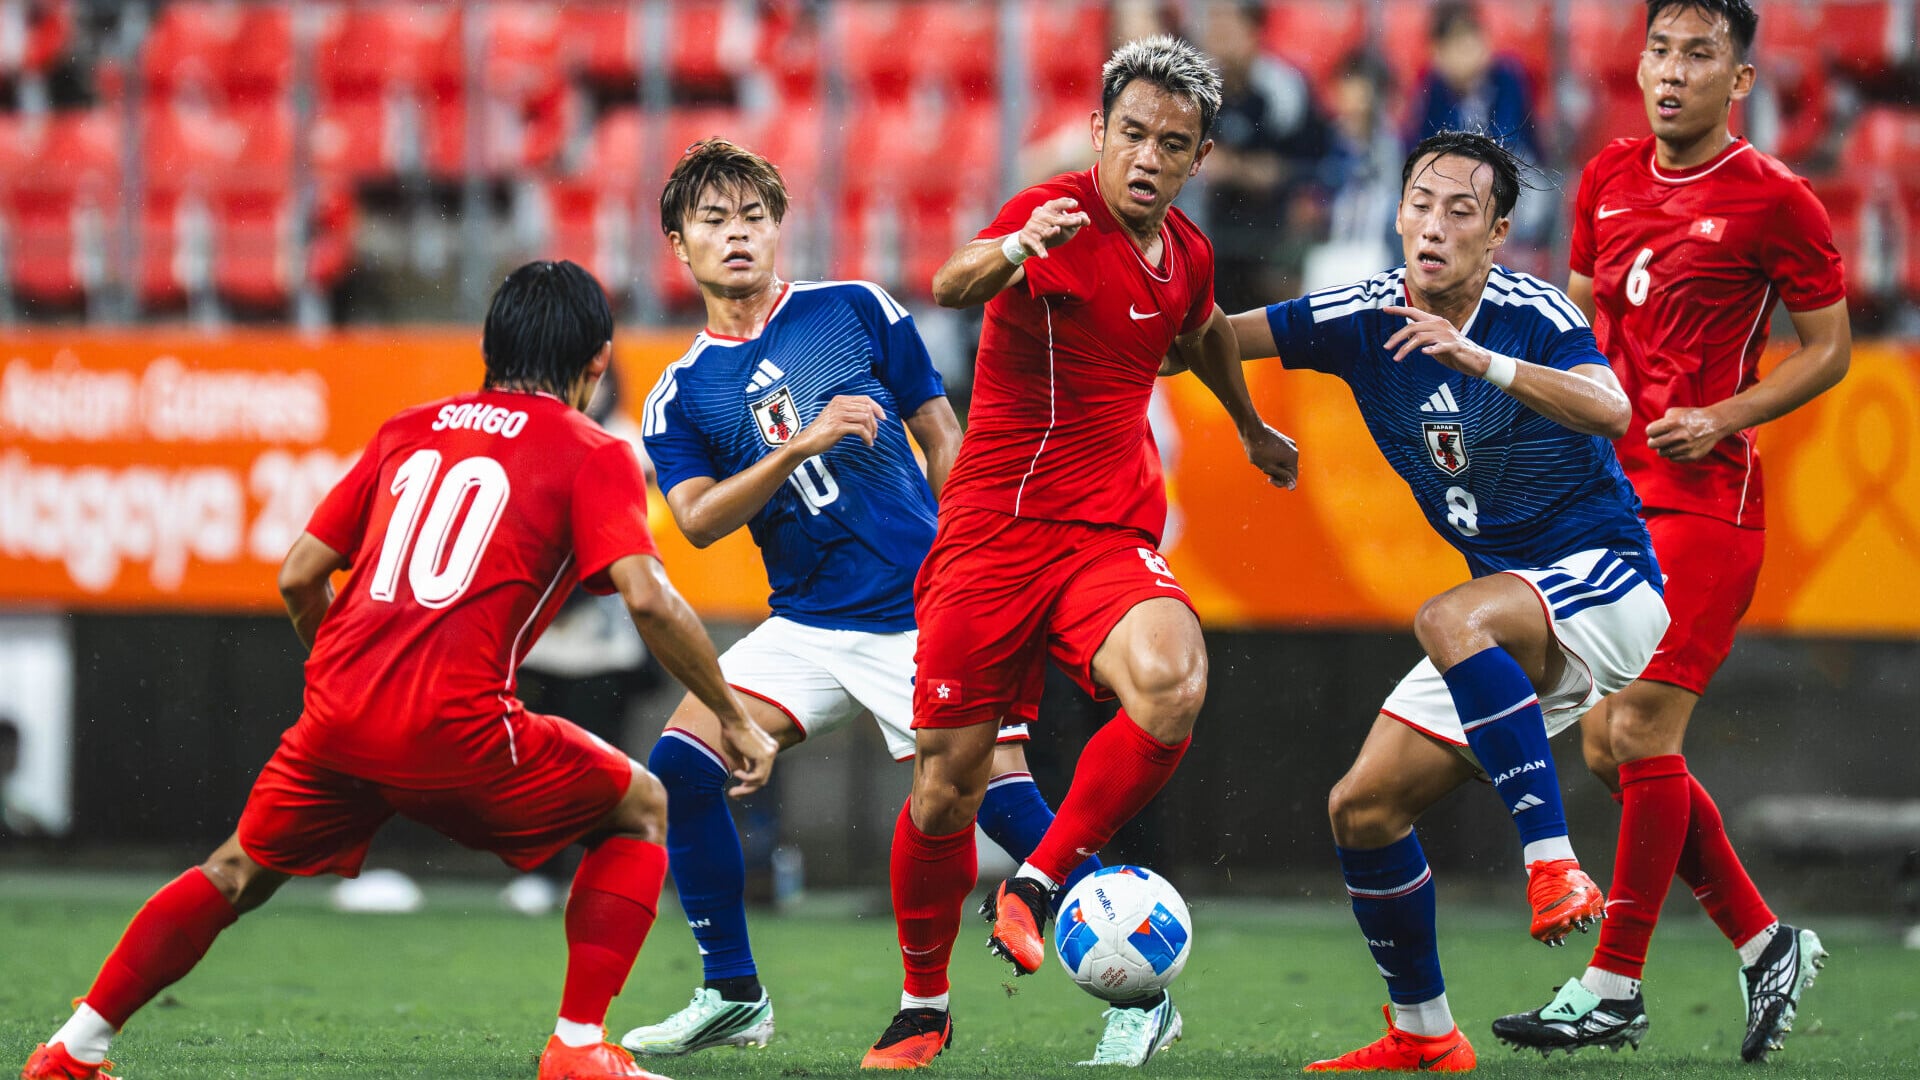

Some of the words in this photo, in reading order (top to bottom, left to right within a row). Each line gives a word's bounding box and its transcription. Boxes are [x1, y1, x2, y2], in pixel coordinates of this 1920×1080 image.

[1626, 248, 1653, 306] 6
[432, 403, 528, 438] SOHGO
[370, 449, 510, 609] 10
[1446, 486, 1480, 536] 8
[1494, 759, 1546, 787] JAPAN
[687, 918, 711, 928] AN
